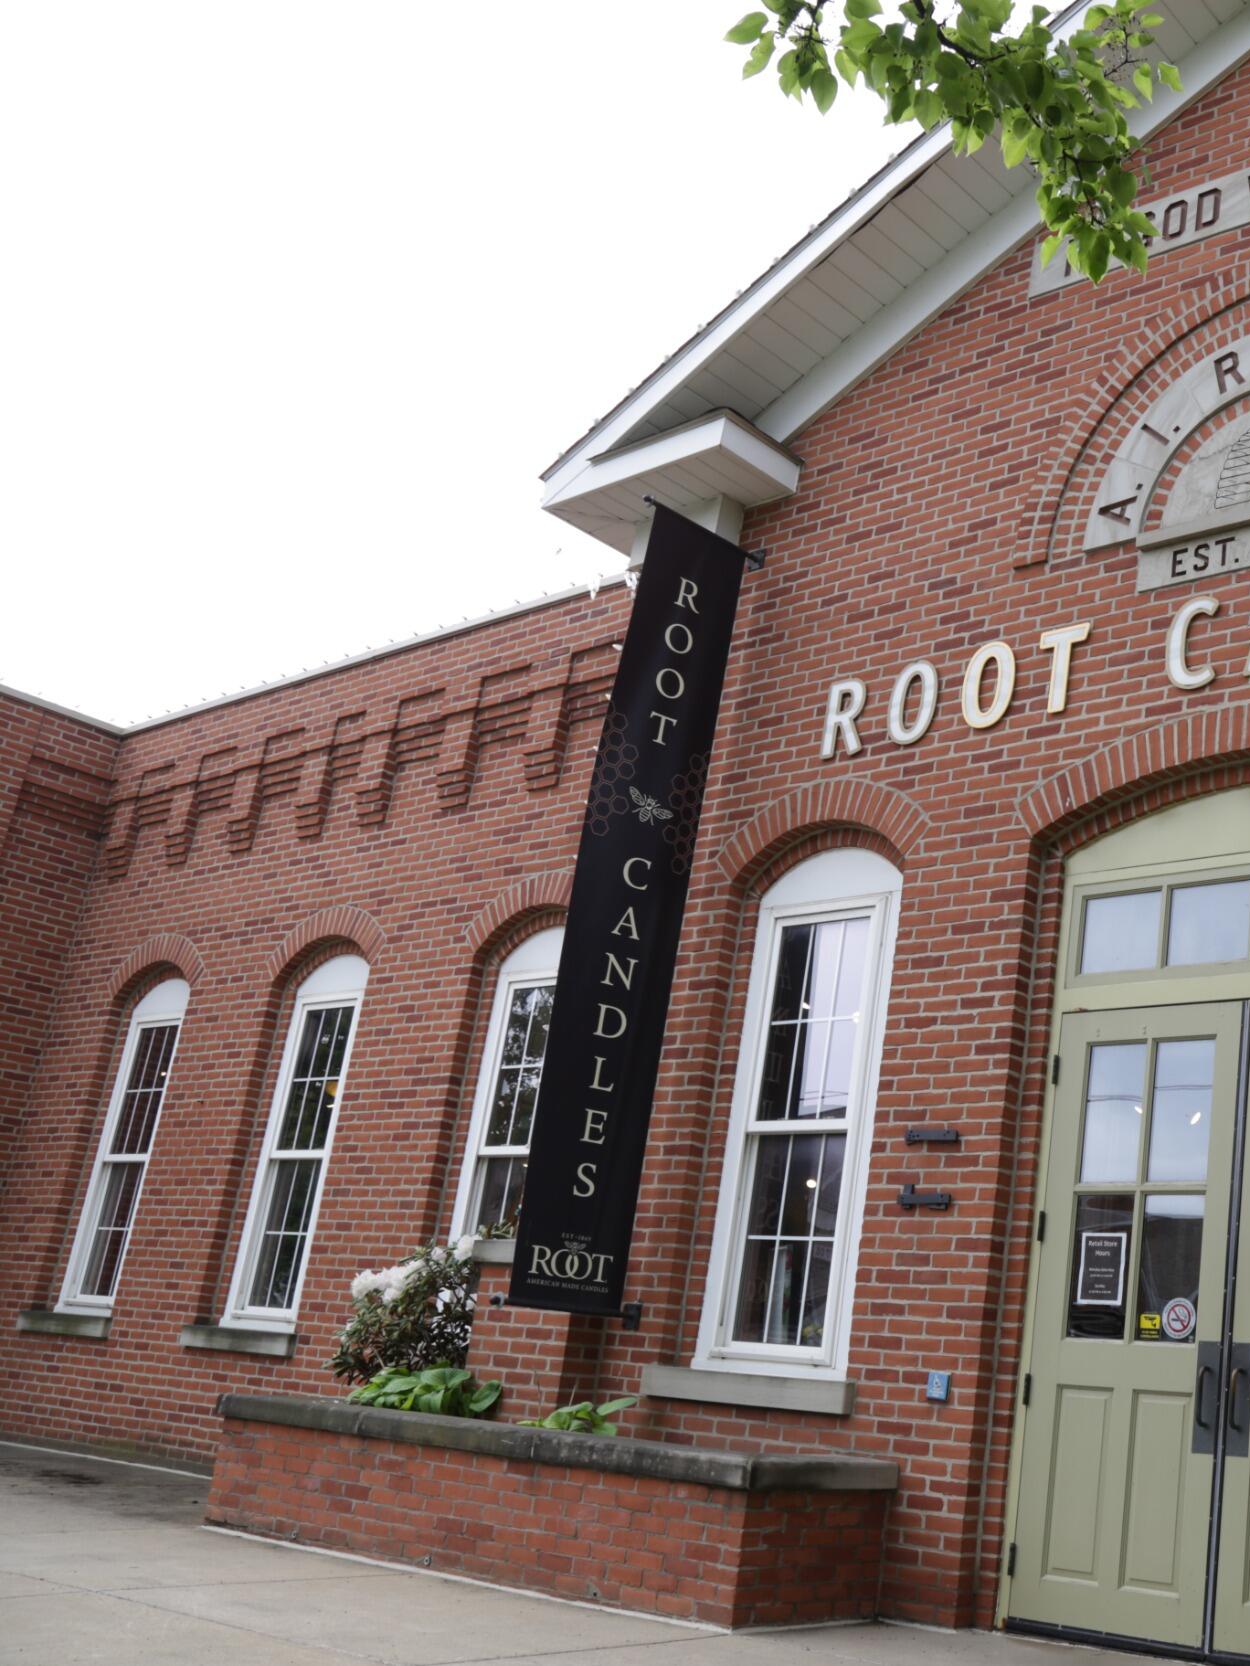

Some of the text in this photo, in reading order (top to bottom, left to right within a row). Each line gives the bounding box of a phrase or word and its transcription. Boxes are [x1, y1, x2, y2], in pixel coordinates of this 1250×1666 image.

[1170, 537, 1240, 578] EST.
[819, 621, 1092, 760] ROOT
[572, 576, 700, 1199] ROOT CANDLES
[527, 1244, 614, 1284] ROOT
